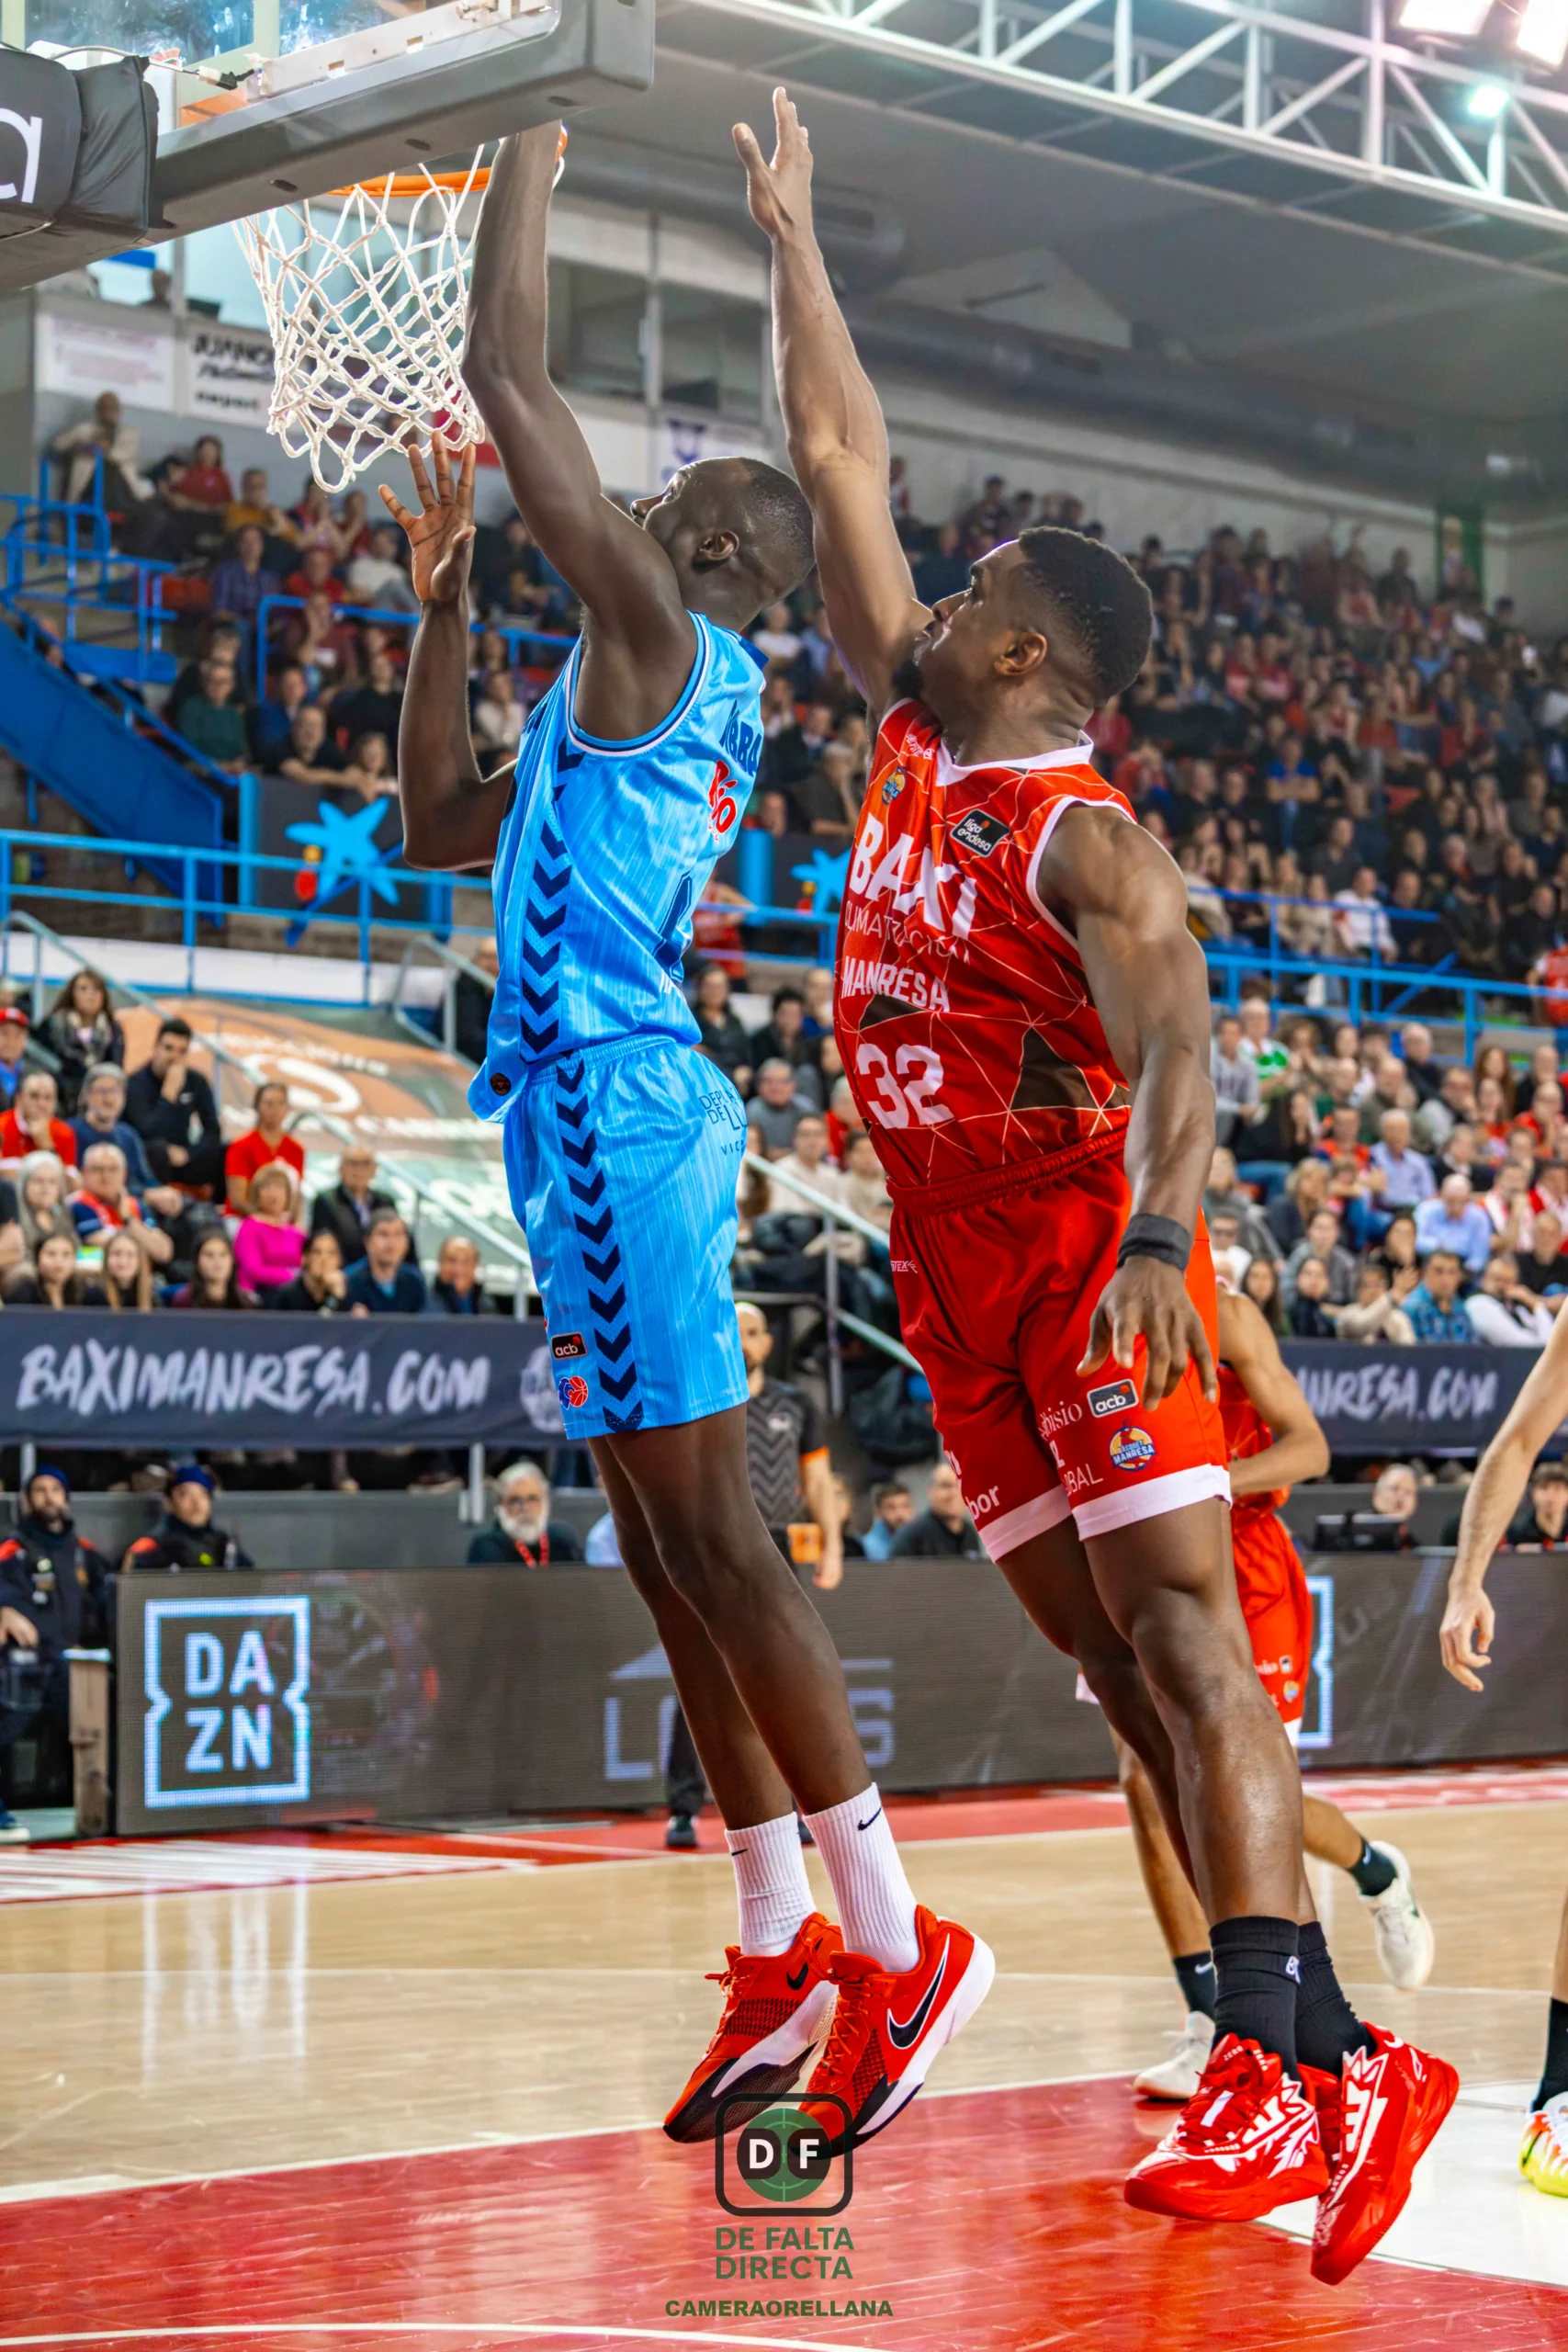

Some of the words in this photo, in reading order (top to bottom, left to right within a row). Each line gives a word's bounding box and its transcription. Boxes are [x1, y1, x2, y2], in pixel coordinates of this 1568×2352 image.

[957, 828, 992, 852] endesa
[964, 818, 983, 834] liga
[841, 956, 950, 1012] MANRESA
[856, 1043, 955, 1129] 32
[555, 1342, 579, 1357] acb
[17, 1338, 491, 1418] BAXIMANRESA.COM
[1095, 1395, 1126, 1413] acb
[1113, 1444, 1155, 1465] MANRESA
[186, 1630, 276, 1698] DA
[186, 1704, 273, 1773] ZN
